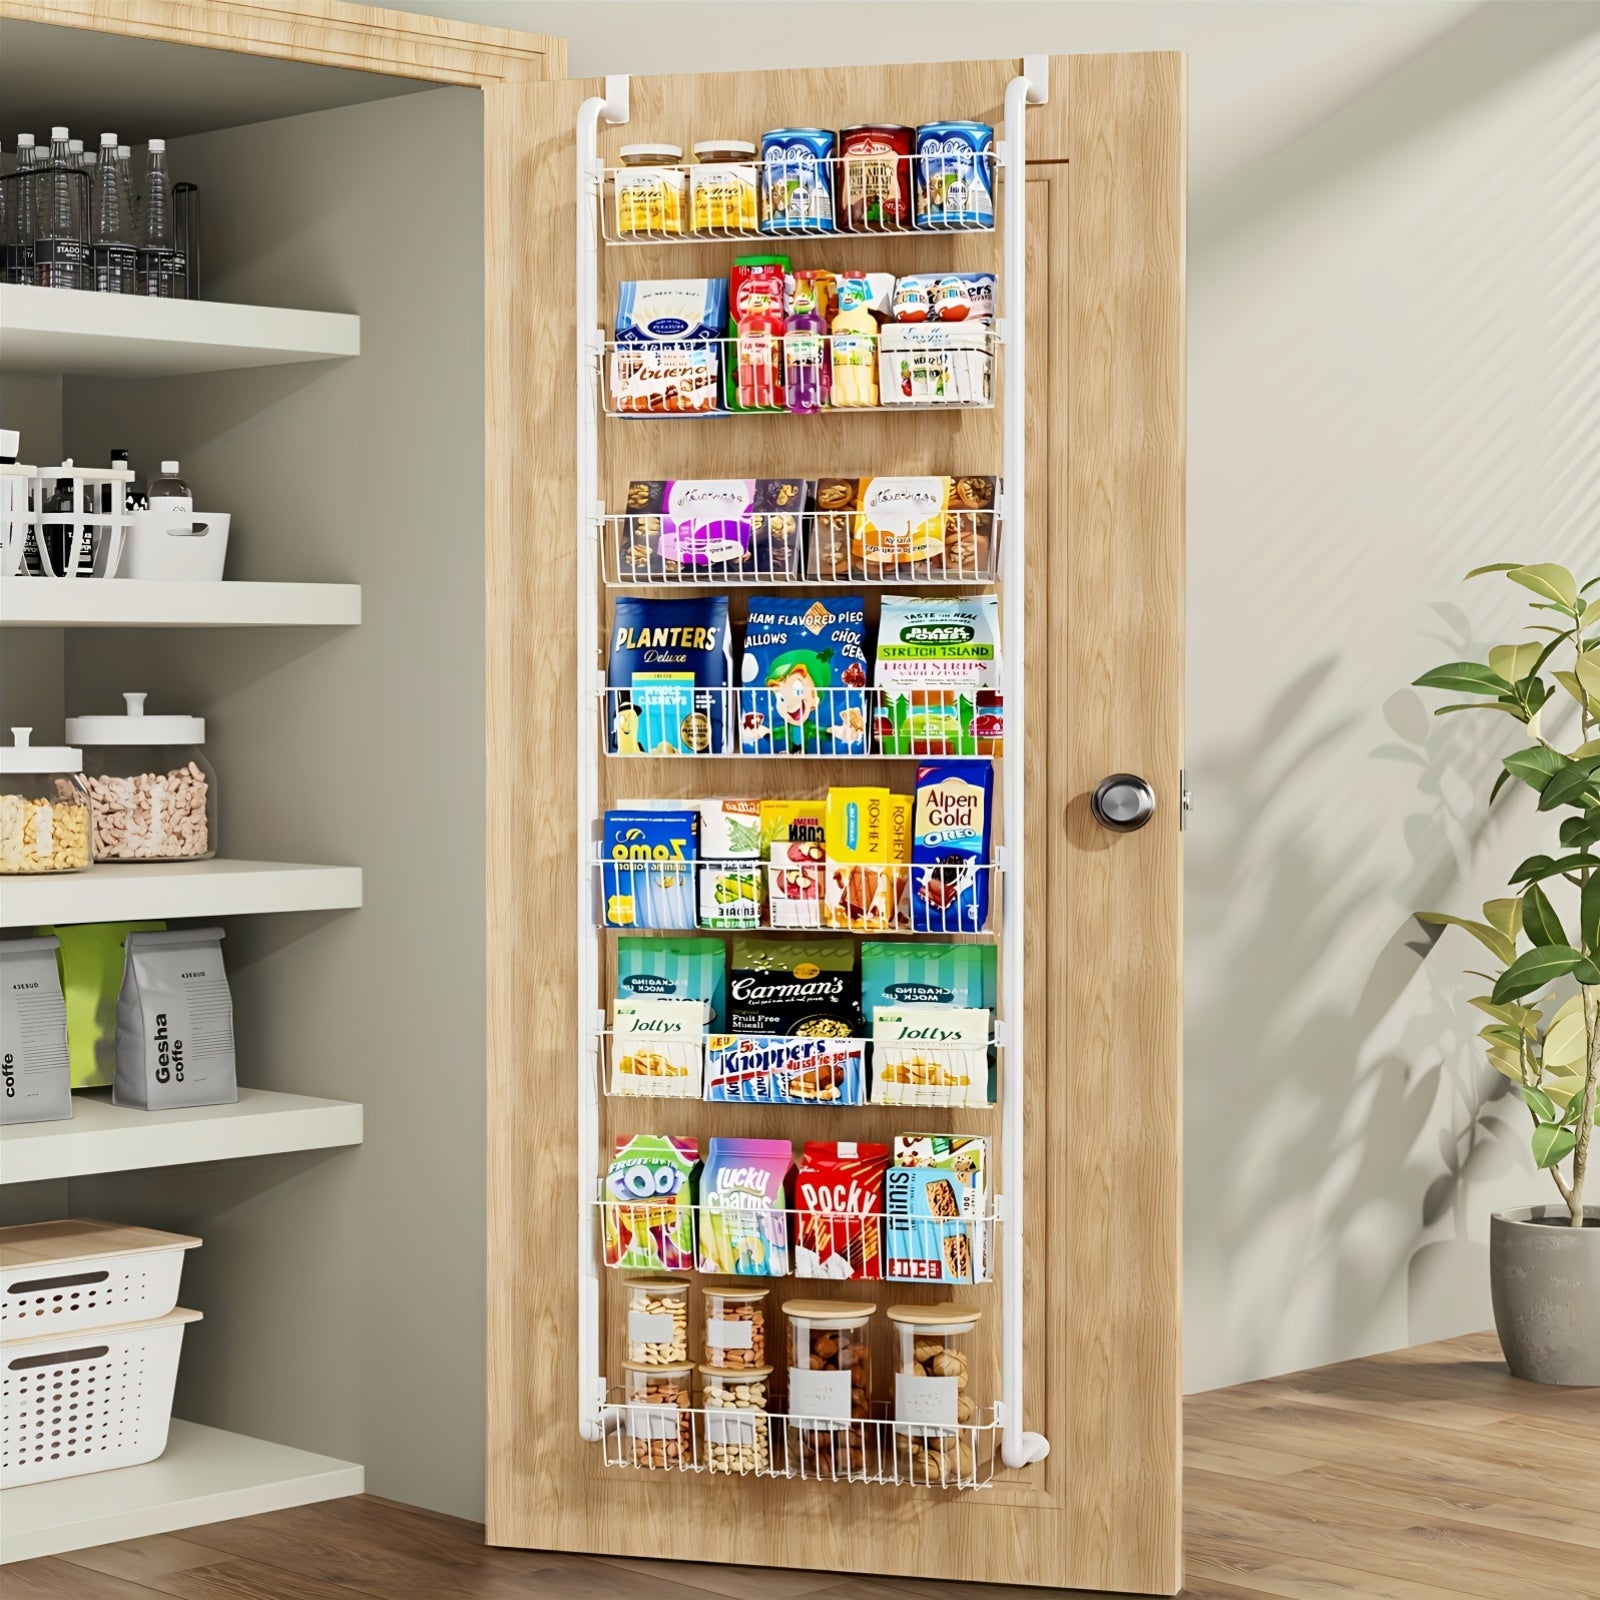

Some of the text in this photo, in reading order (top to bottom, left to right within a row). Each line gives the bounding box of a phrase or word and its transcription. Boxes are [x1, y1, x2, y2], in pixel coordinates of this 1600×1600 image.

[749, 612, 775, 624] HAM
[778, 614, 836, 626] FLAVORED
[616, 627, 718, 652] PLANTERS
[643, 649, 687, 663] Deluxe
[926, 789, 978, 812] Alpen
[868, 799, 880, 852] ROSHEN
[929, 809, 972, 826] Gold
[892, 806, 905, 859] ROSHEN
[924, 829, 976, 846] OREO
[732, 977, 843, 1000] Carman's
[630, 1019, 682, 1033] Jollys
[732, 1014, 780, 1022] Fruit Free
[897, 1027, 962, 1041] Jollys
[154, 1013, 171, 1084] Gesha
[172, 1040, 185, 1082] coffe
[2, 1053, 15, 1098] coffe
[609, 1158, 648, 1174] FRUIT
[717, 1166, 770, 1196] Lucky
[707, 1191, 772, 1215] Charms
